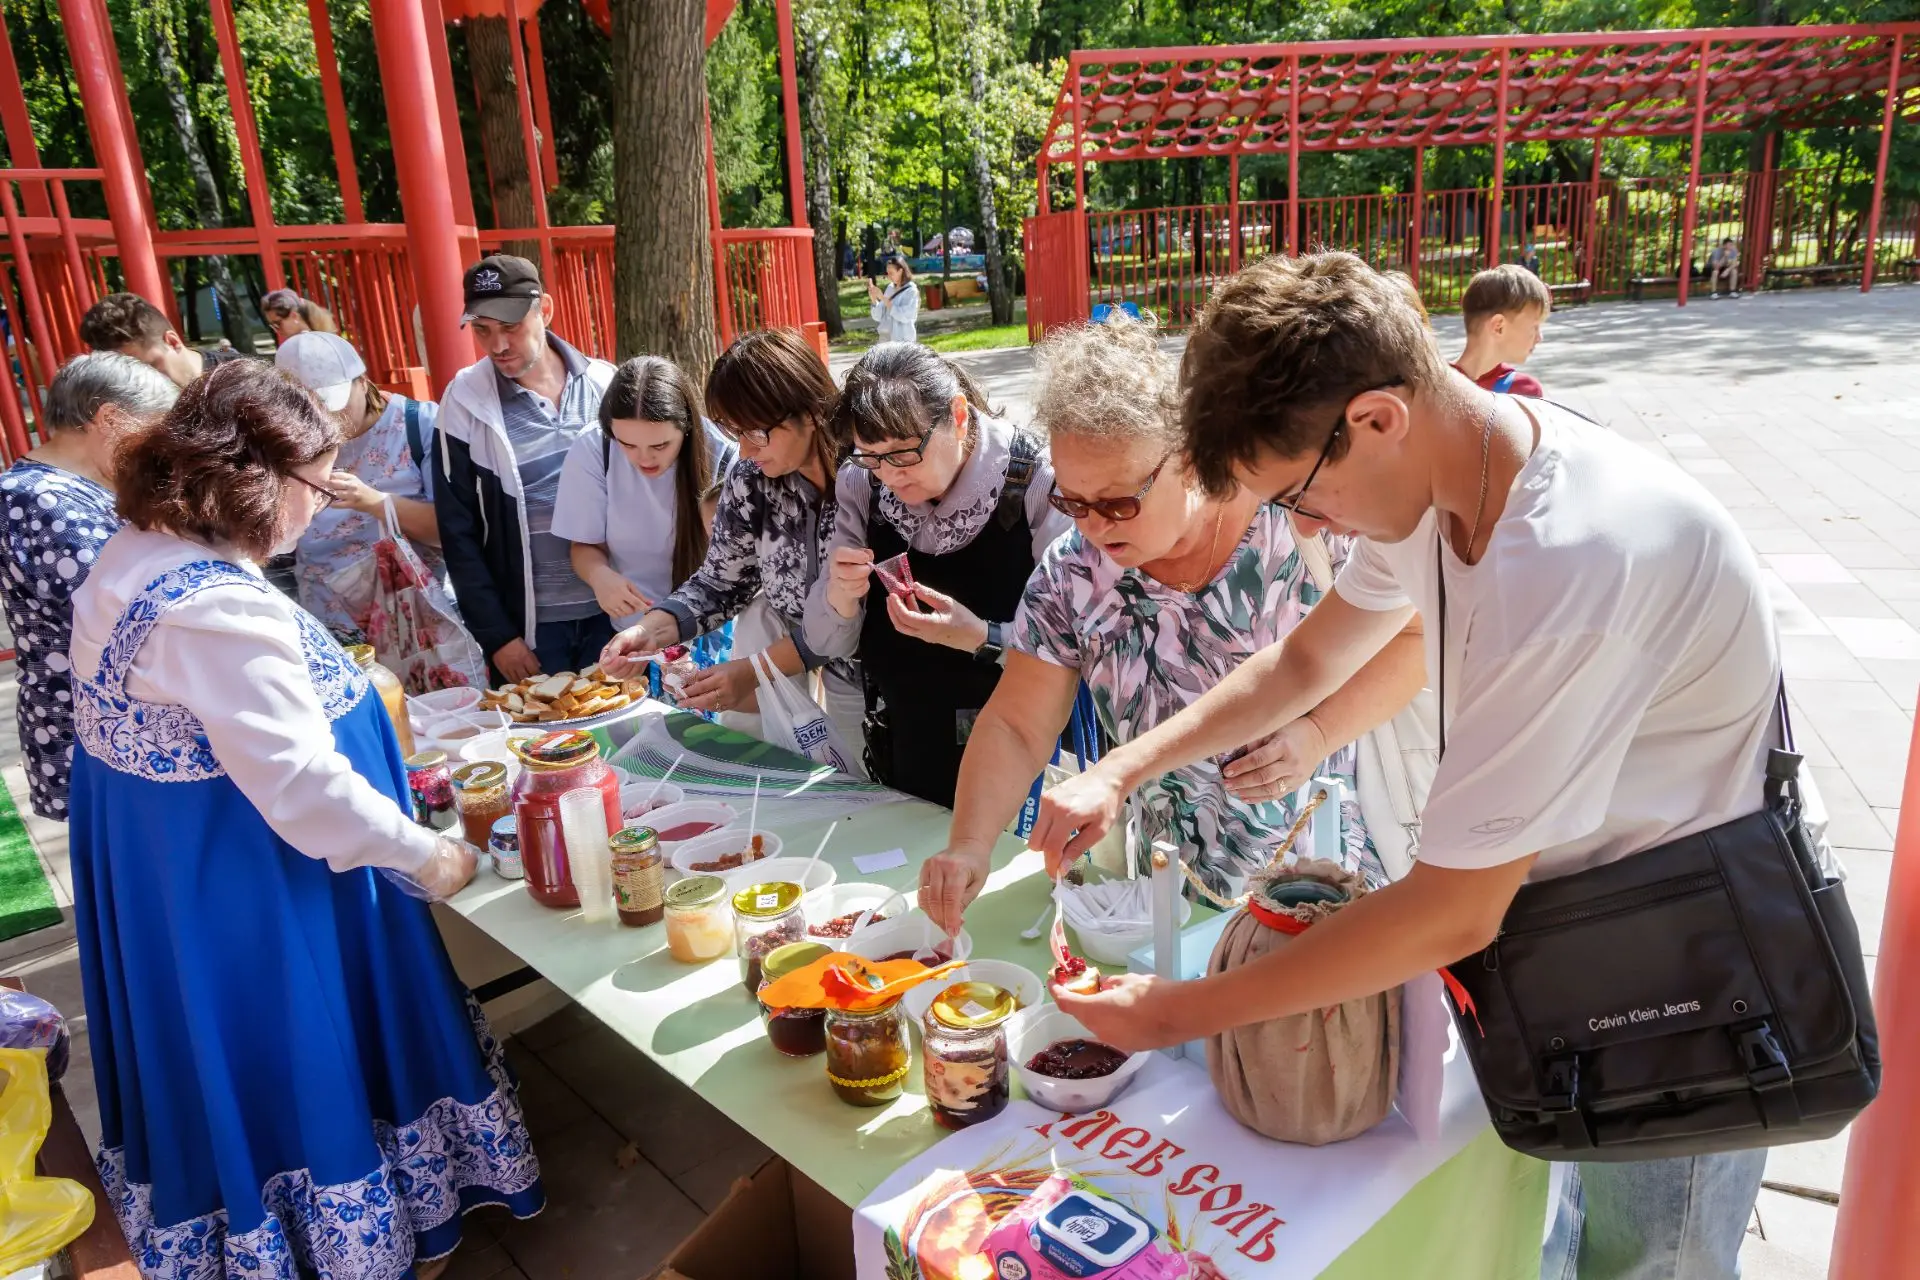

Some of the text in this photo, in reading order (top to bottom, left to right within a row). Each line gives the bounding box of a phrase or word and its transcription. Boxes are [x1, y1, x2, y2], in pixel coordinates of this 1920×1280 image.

[1588, 1000, 1701, 1032] Calvin Klein Jeans
[1168, 1164, 1287, 1262] СОЛЬ
[1065, 1219, 1097, 1241] Emily
[1002, 1259, 1023, 1275] Emily
